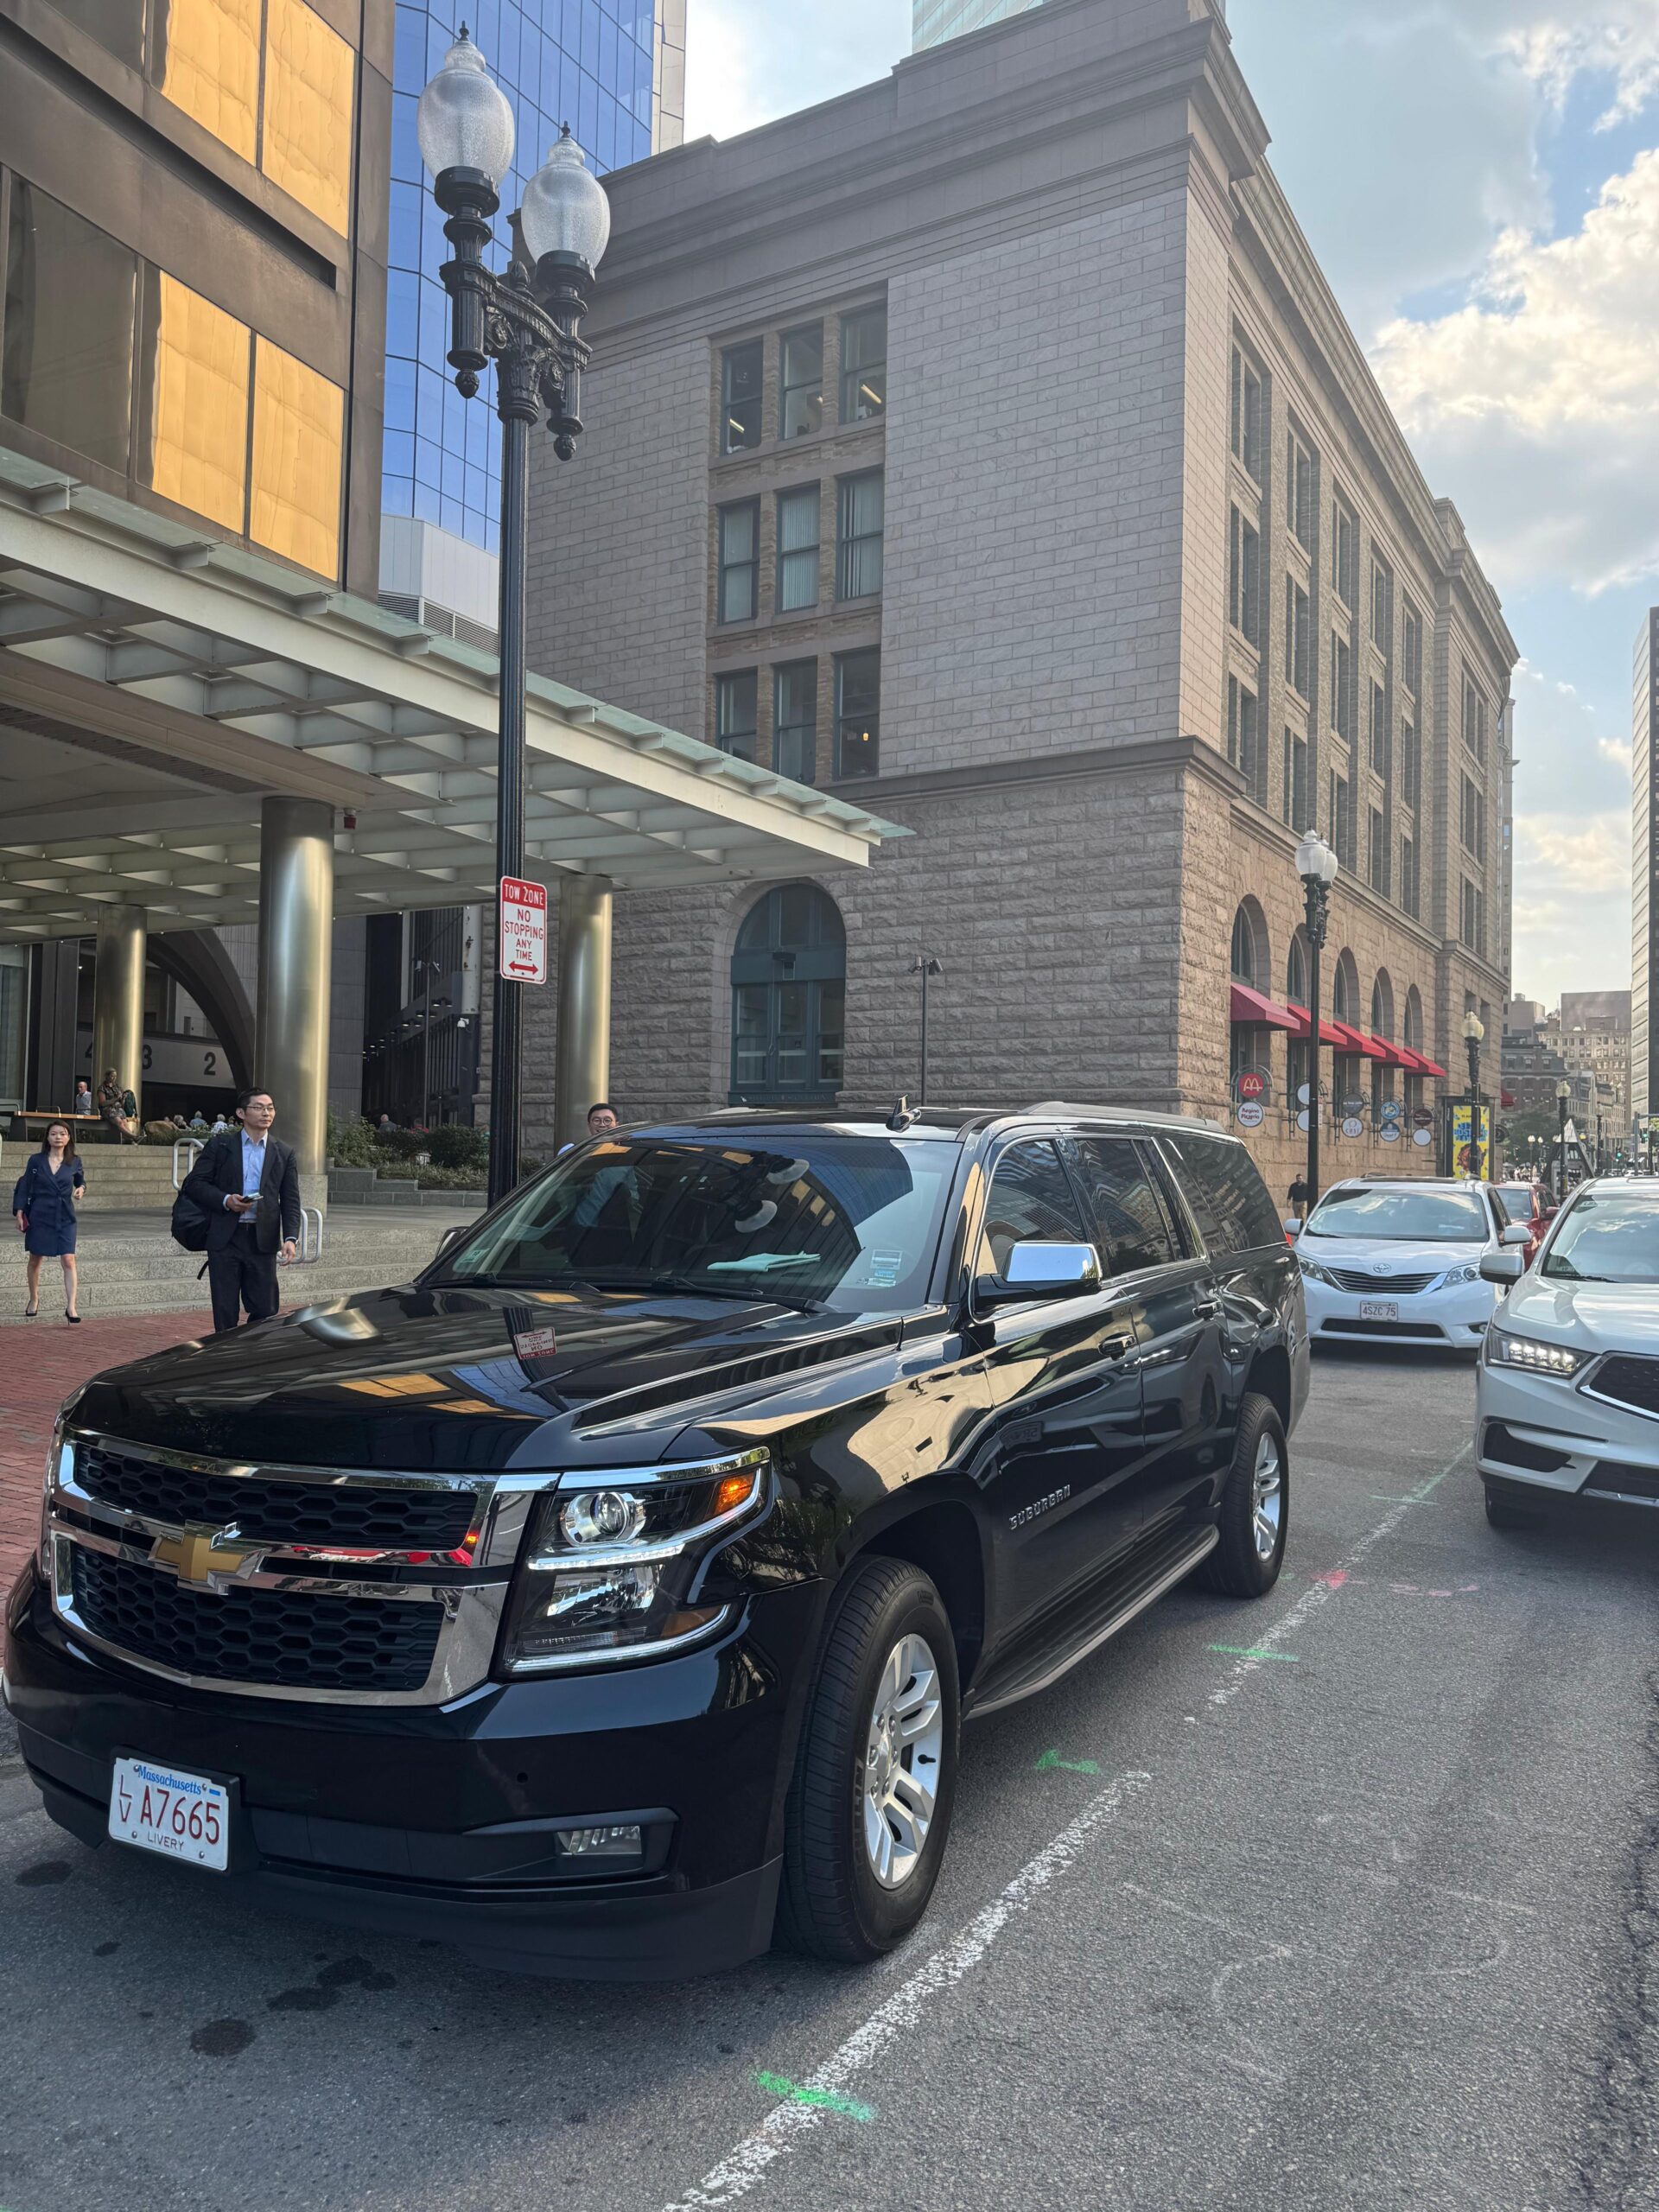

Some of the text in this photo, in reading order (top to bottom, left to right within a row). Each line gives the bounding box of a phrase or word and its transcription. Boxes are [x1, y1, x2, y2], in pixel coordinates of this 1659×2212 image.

[504, 883, 544, 906] TOW ZONE
[517, 908, 531, 923] NO
[504, 920, 543, 940] STOPPING
[515, 938, 532, 950] ANY
[515, 949, 533, 962] TIME
[142, 1044, 153, 1070] 3
[203, 1052, 216, 1075] 2
[1363, 1306, 1396, 1317] 4SZC 75
[1008, 1484, 1071, 1531] SUBURBAN
[137, 1764, 202, 1796] Massachusetts
[140, 1784, 220, 1846] A7665
[147, 1831, 185, 1852] LIVERY
